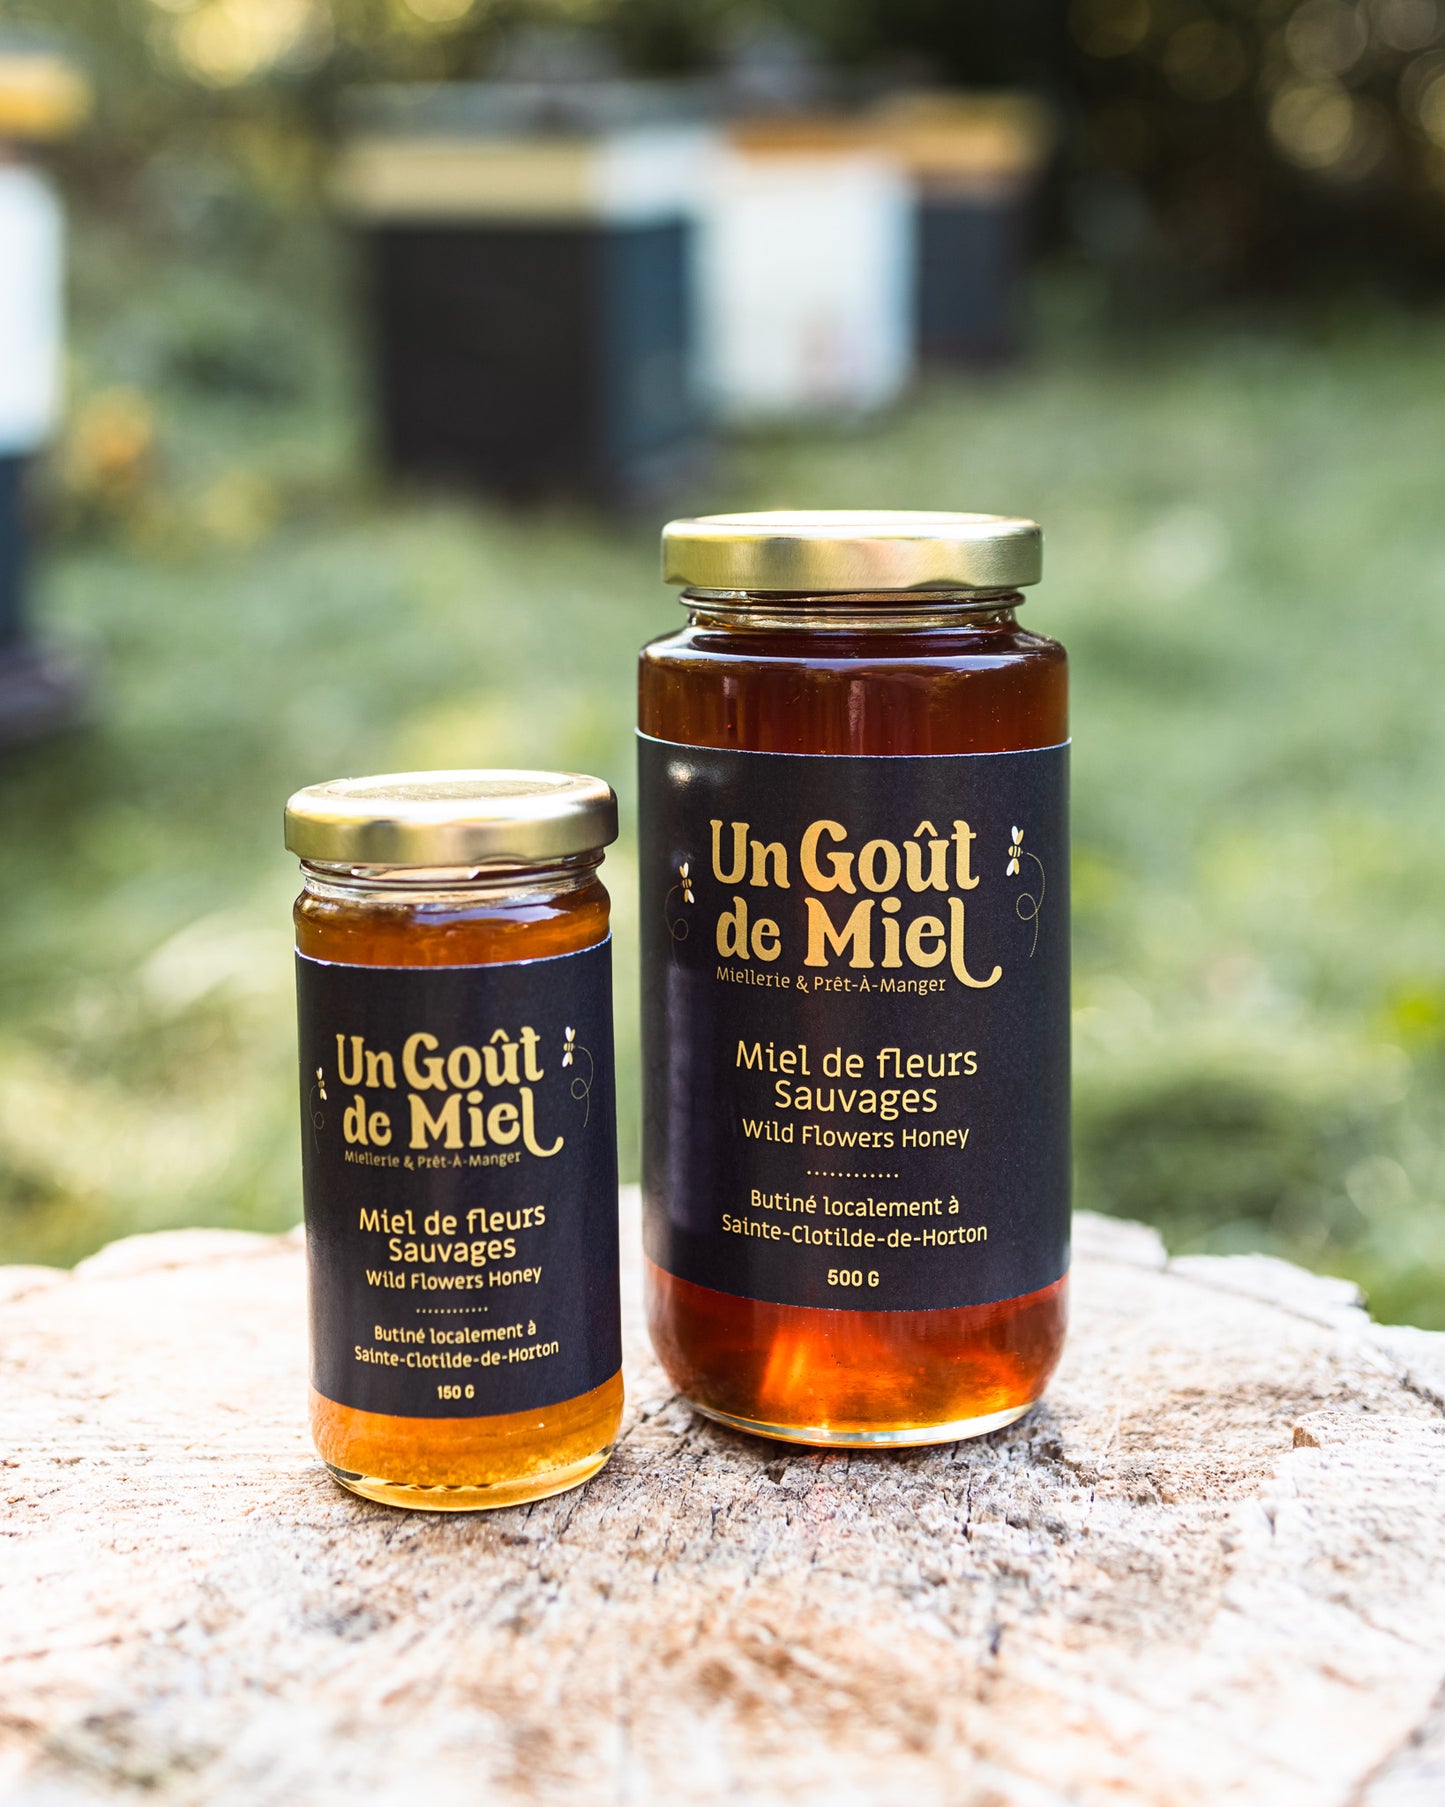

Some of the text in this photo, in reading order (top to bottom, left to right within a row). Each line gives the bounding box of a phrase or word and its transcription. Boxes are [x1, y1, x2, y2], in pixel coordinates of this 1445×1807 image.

[710, 819, 980, 894] Un Goût
[716, 896, 1002, 988] de Miel
[716, 966, 946, 996] Miellerie & Prêt-À-Manger
[336, 1026, 544, 1091] Un Goût
[736, 1040, 978, 1079] Miel de fleurs
[774, 1080, 938, 1121] Sauvages
[343, 1087, 564, 1157] de Miel
[742, 1119, 969, 1149] Wild Flowers Honey
[344, 1150, 522, 1170] Miellerie & Prêt-À-Manger
[751, 1190, 959, 1217] Butiné localement à
[360, 1205, 546, 1235] Miel de fleurs
[722, 1215, 987, 1247] Sainte-Clotilde-de-Horton
[389, 1238, 516, 1267] Sauvages
[366, 1266, 542, 1290] Wild Flowers Honey
[827, 1269, 880, 1287] 500 G
[374, 1320, 536, 1344] Butiné localement à
[354, 1340, 558, 1368] Sainte-Clotilde-de-Horton
[437, 1386, 474, 1399] 150 G
